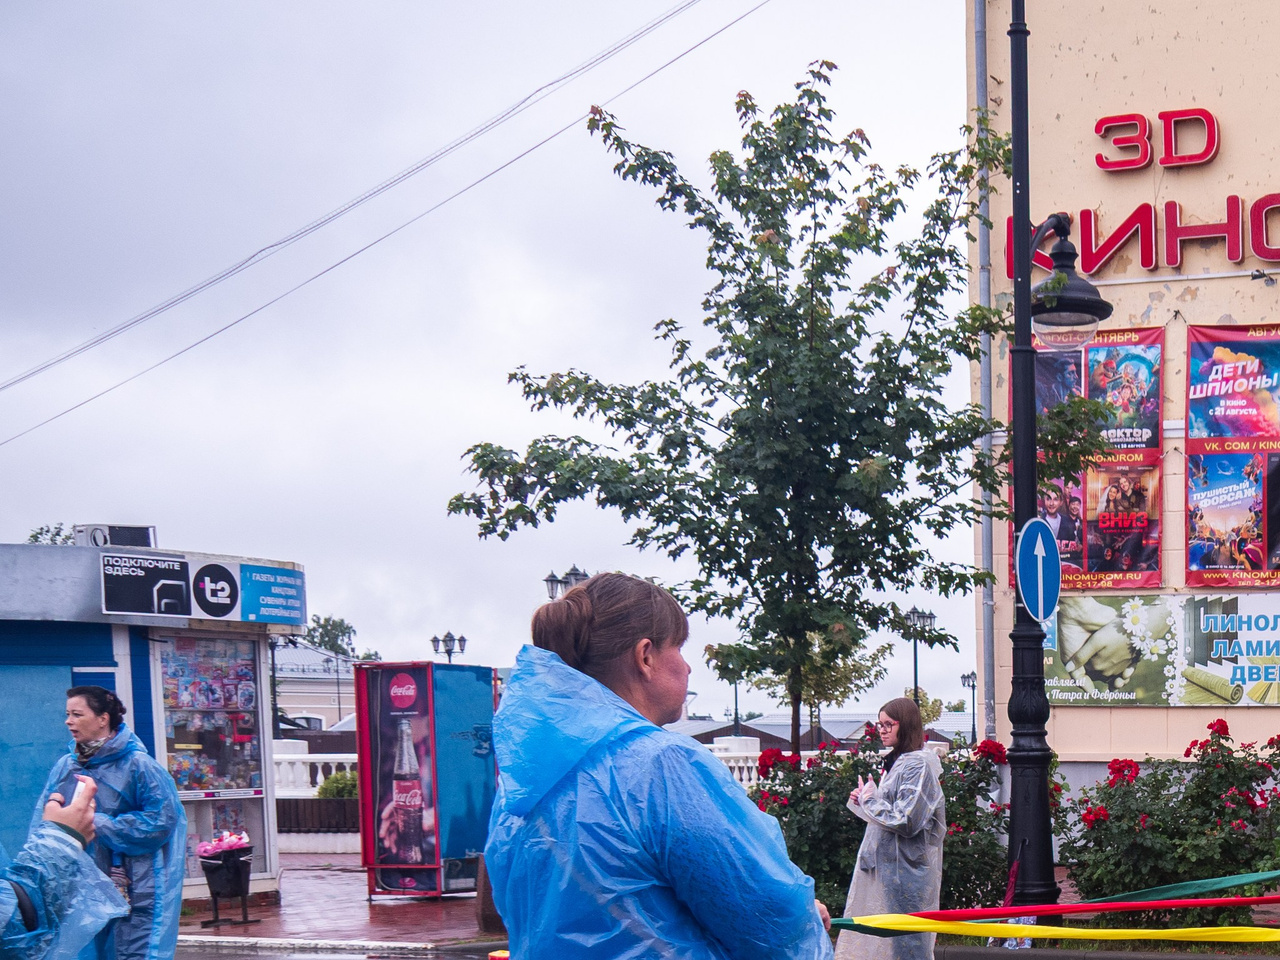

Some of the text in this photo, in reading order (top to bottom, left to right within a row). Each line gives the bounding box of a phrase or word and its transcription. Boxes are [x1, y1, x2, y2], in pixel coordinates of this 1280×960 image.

[1094, 108, 1221, 172] 3D
[1208, 359, 1260, 382] ДЕТИ
[1189, 373, 1279, 399] ШПИОНЫ
[1215, 407, 1225, 416] 21
[1226, 408, 1258, 416] АВГУСТА
[1193, 479, 1250, 500] ПУШИСТЫЙ
[1200, 487, 1256, 508] ФОРСАЖ
[1098, 511, 1148, 528] ВНИЗ
[104, 556, 181, 571] ПОДКЛЮЧИТЕ
[104, 566, 146, 577] ЗДЕСЬ
[1060, 573, 1142, 581] INOMUROM.RU
[1051, 688, 1081, 702] Петра
[1083, 692, 1089, 700] и
[1091, 688, 1137, 702] Февроньи
